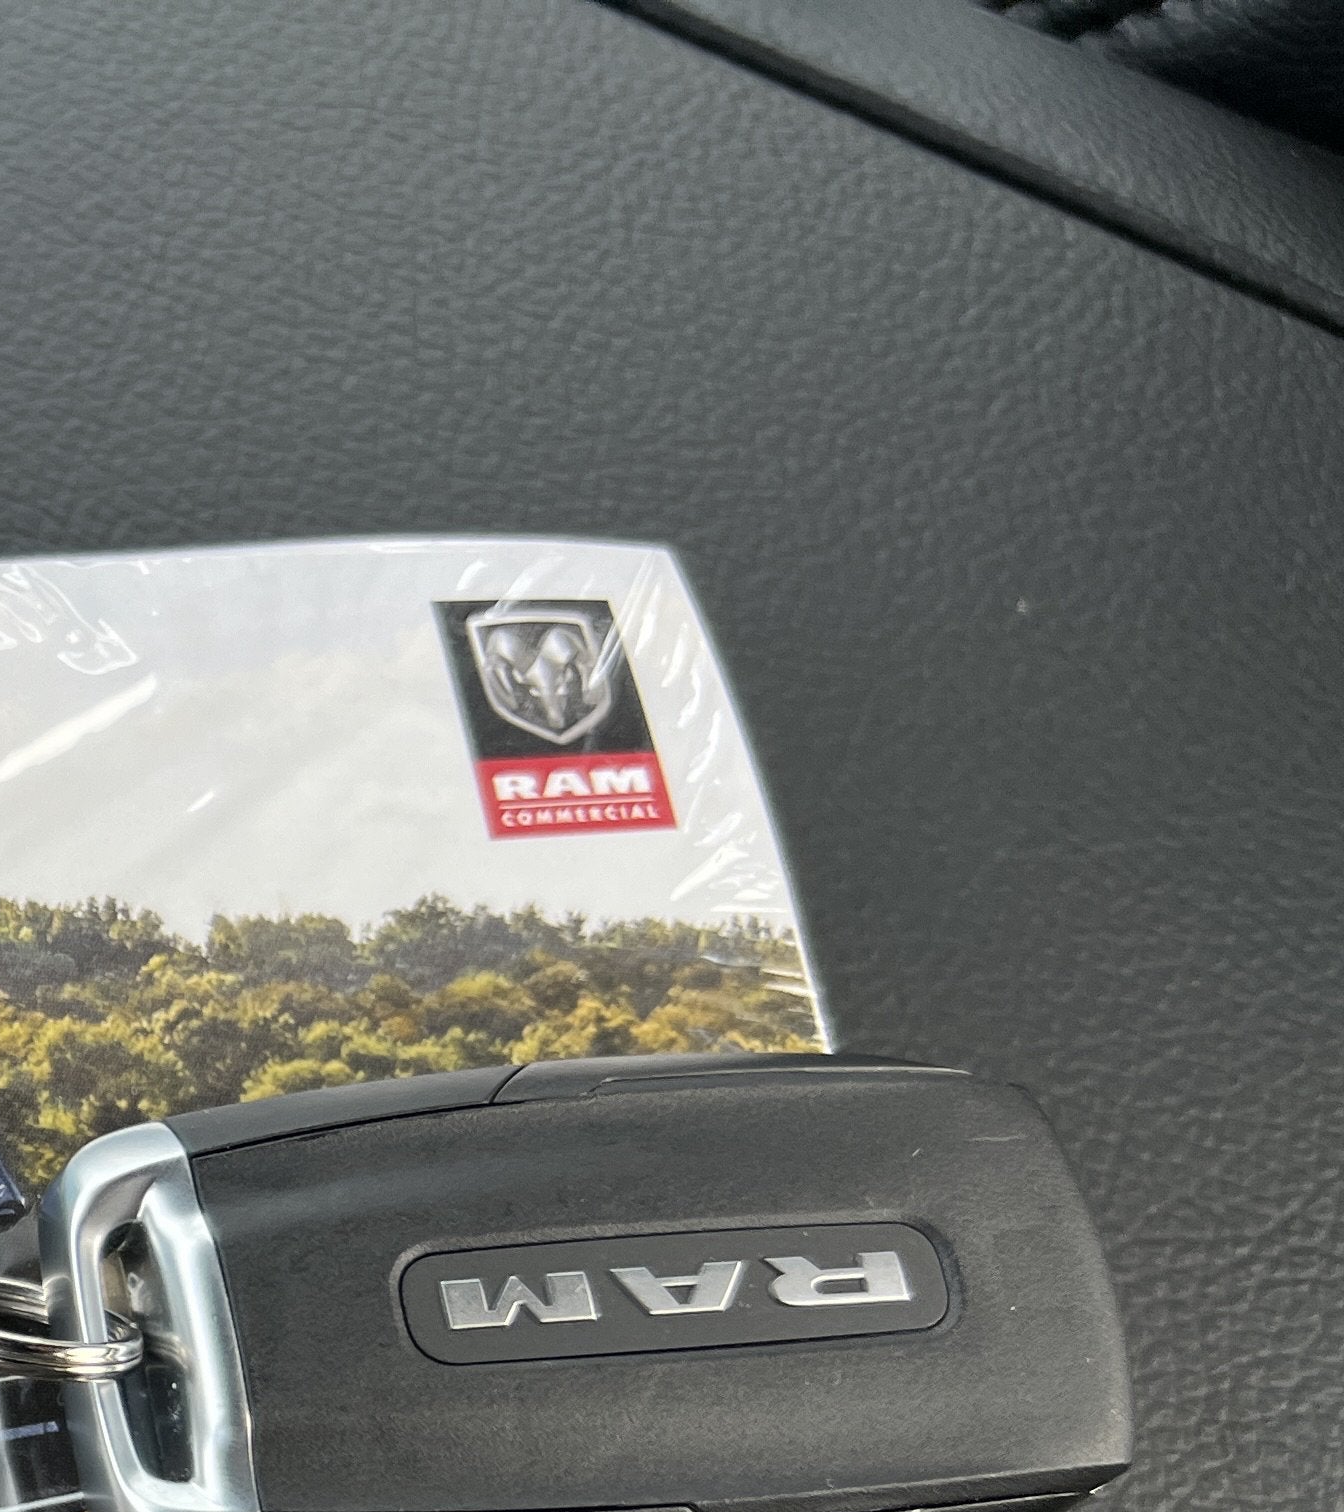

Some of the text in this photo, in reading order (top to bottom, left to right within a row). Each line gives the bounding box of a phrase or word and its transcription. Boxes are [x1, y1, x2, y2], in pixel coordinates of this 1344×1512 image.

[491, 766, 652, 801] RAM
[500, 803, 661, 828] COMMERCIAL
[440, 1250, 912, 1330] RAM
